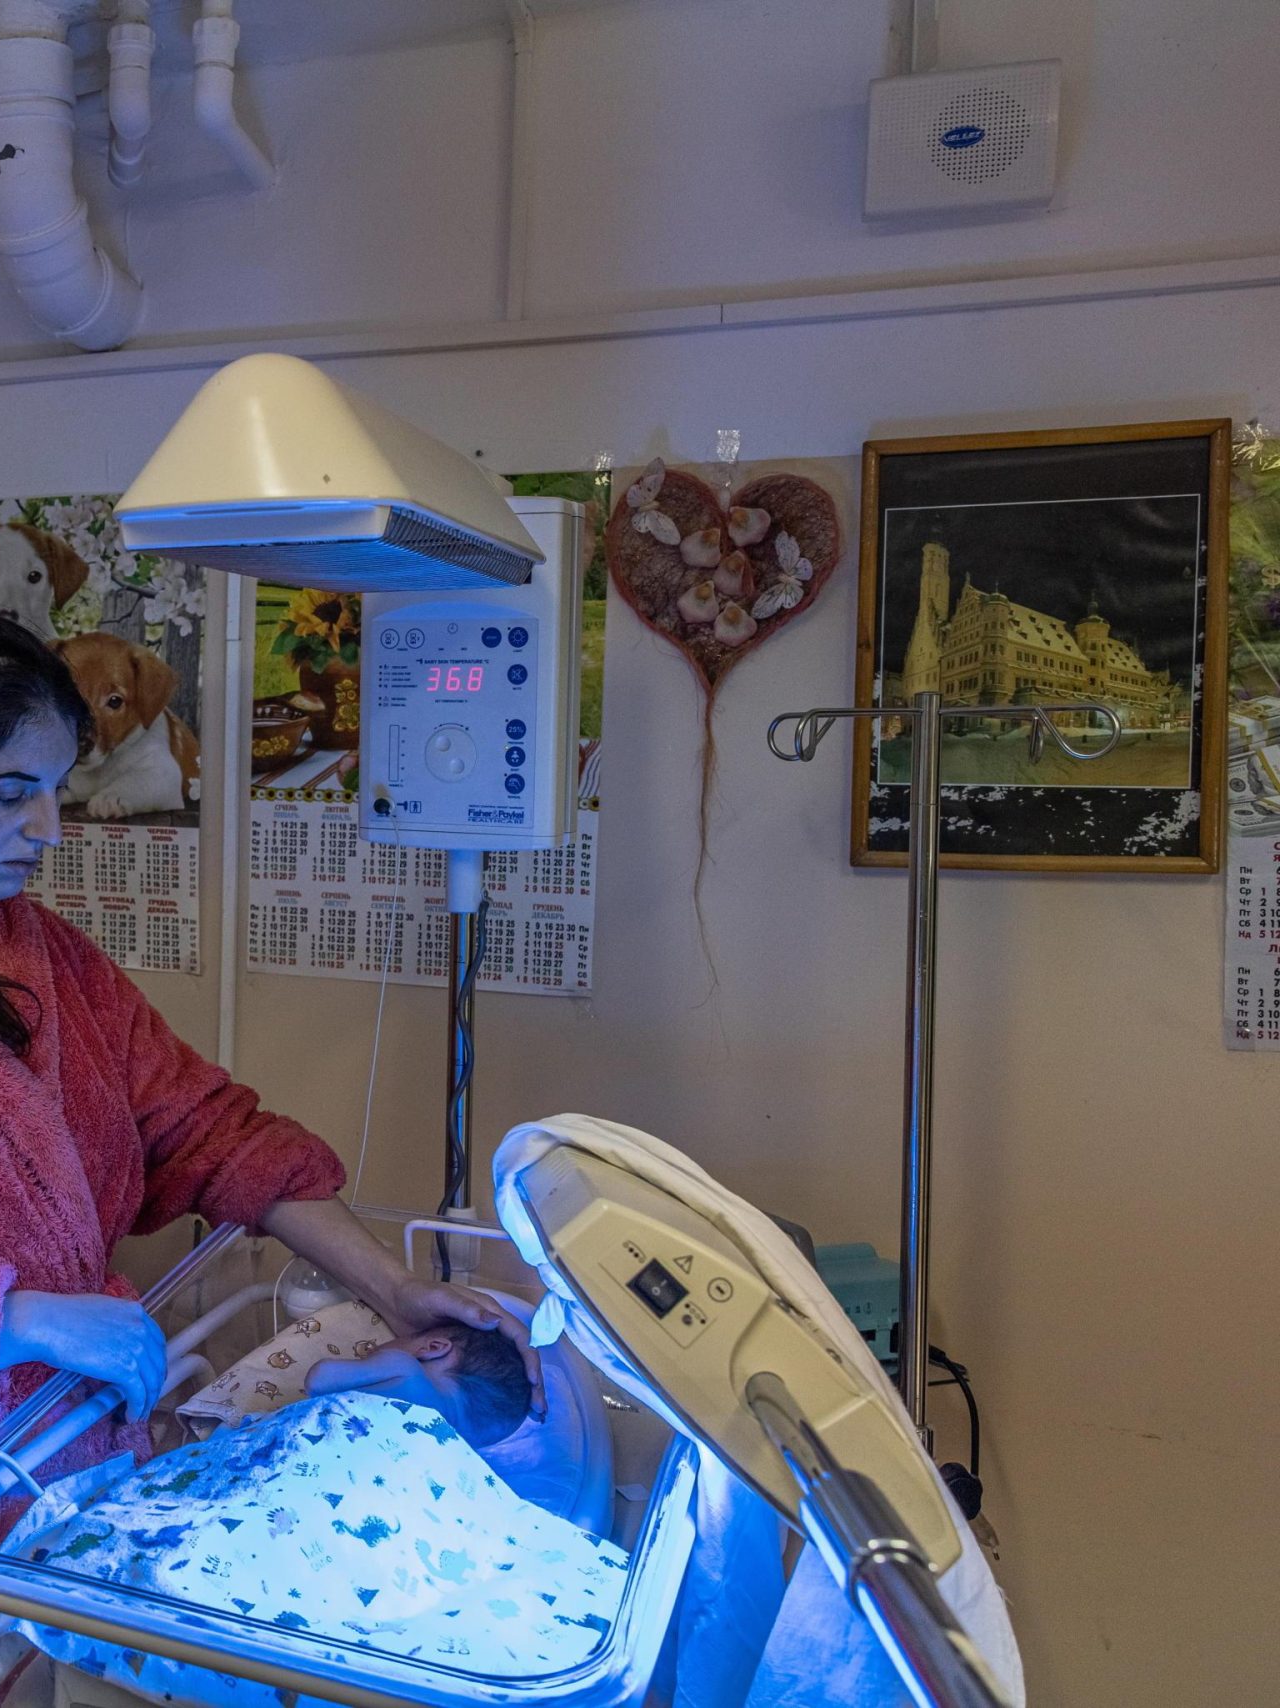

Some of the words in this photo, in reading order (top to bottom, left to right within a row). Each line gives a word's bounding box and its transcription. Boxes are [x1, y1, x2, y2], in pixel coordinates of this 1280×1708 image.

[468, 808, 492, 817] Fisher
[498, 810, 524, 819] Paykel
[1240, 866, 1252, 874] Пн
[1240, 887, 1251, 896] Ср
[1261, 887, 1265, 896] 1
[1260, 898, 1267, 906] 2
[1260, 909, 1266, 917] 3
[525, 921, 530, 929] 2
[535, 922, 540, 930] 9
[544, 922, 553, 930] 16
[555, 923, 565, 931] 23
[566, 924, 576, 932] 30
[555, 932, 564, 940] 24
[566, 933, 575, 941] 31
[579, 934, 588, 942] Вт
[1259, 930, 1266, 938] 5
[533, 940, 541, 948] 11
[543, 941, 552, 949] 18
[554, 941, 564, 949] 25
[524, 948, 529, 956] 5
[532, 949, 541, 957] 12
[543, 950, 552, 958] 19
[554, 951, 563, 959] 26
[1238, 967, 1250, 975] Пн
[1274, 968, 1280, 976] 6
[1274, 978, 1280, 987] 7
[1237, 987, 1249, 996] Ср
[1259, 988, 1263, 997] 1
[1274, 989, 1280, 997] 8
[1258, 999, 1264, 1007] 2
[1274, 999, 1280, 1008] 9
[1258, 1010, 1264, 1018] 3
[1268, 1010, 1280, 1019] 10
[1236, 1020, 1248, 1028] Сб
[1257, 1020, 1264, 1028] 4
[1268, 1020, 1278, 1029] 11
[1257, 1031, 1264, 1039] 5
[1268, 1032, 1279, 1040] 12
